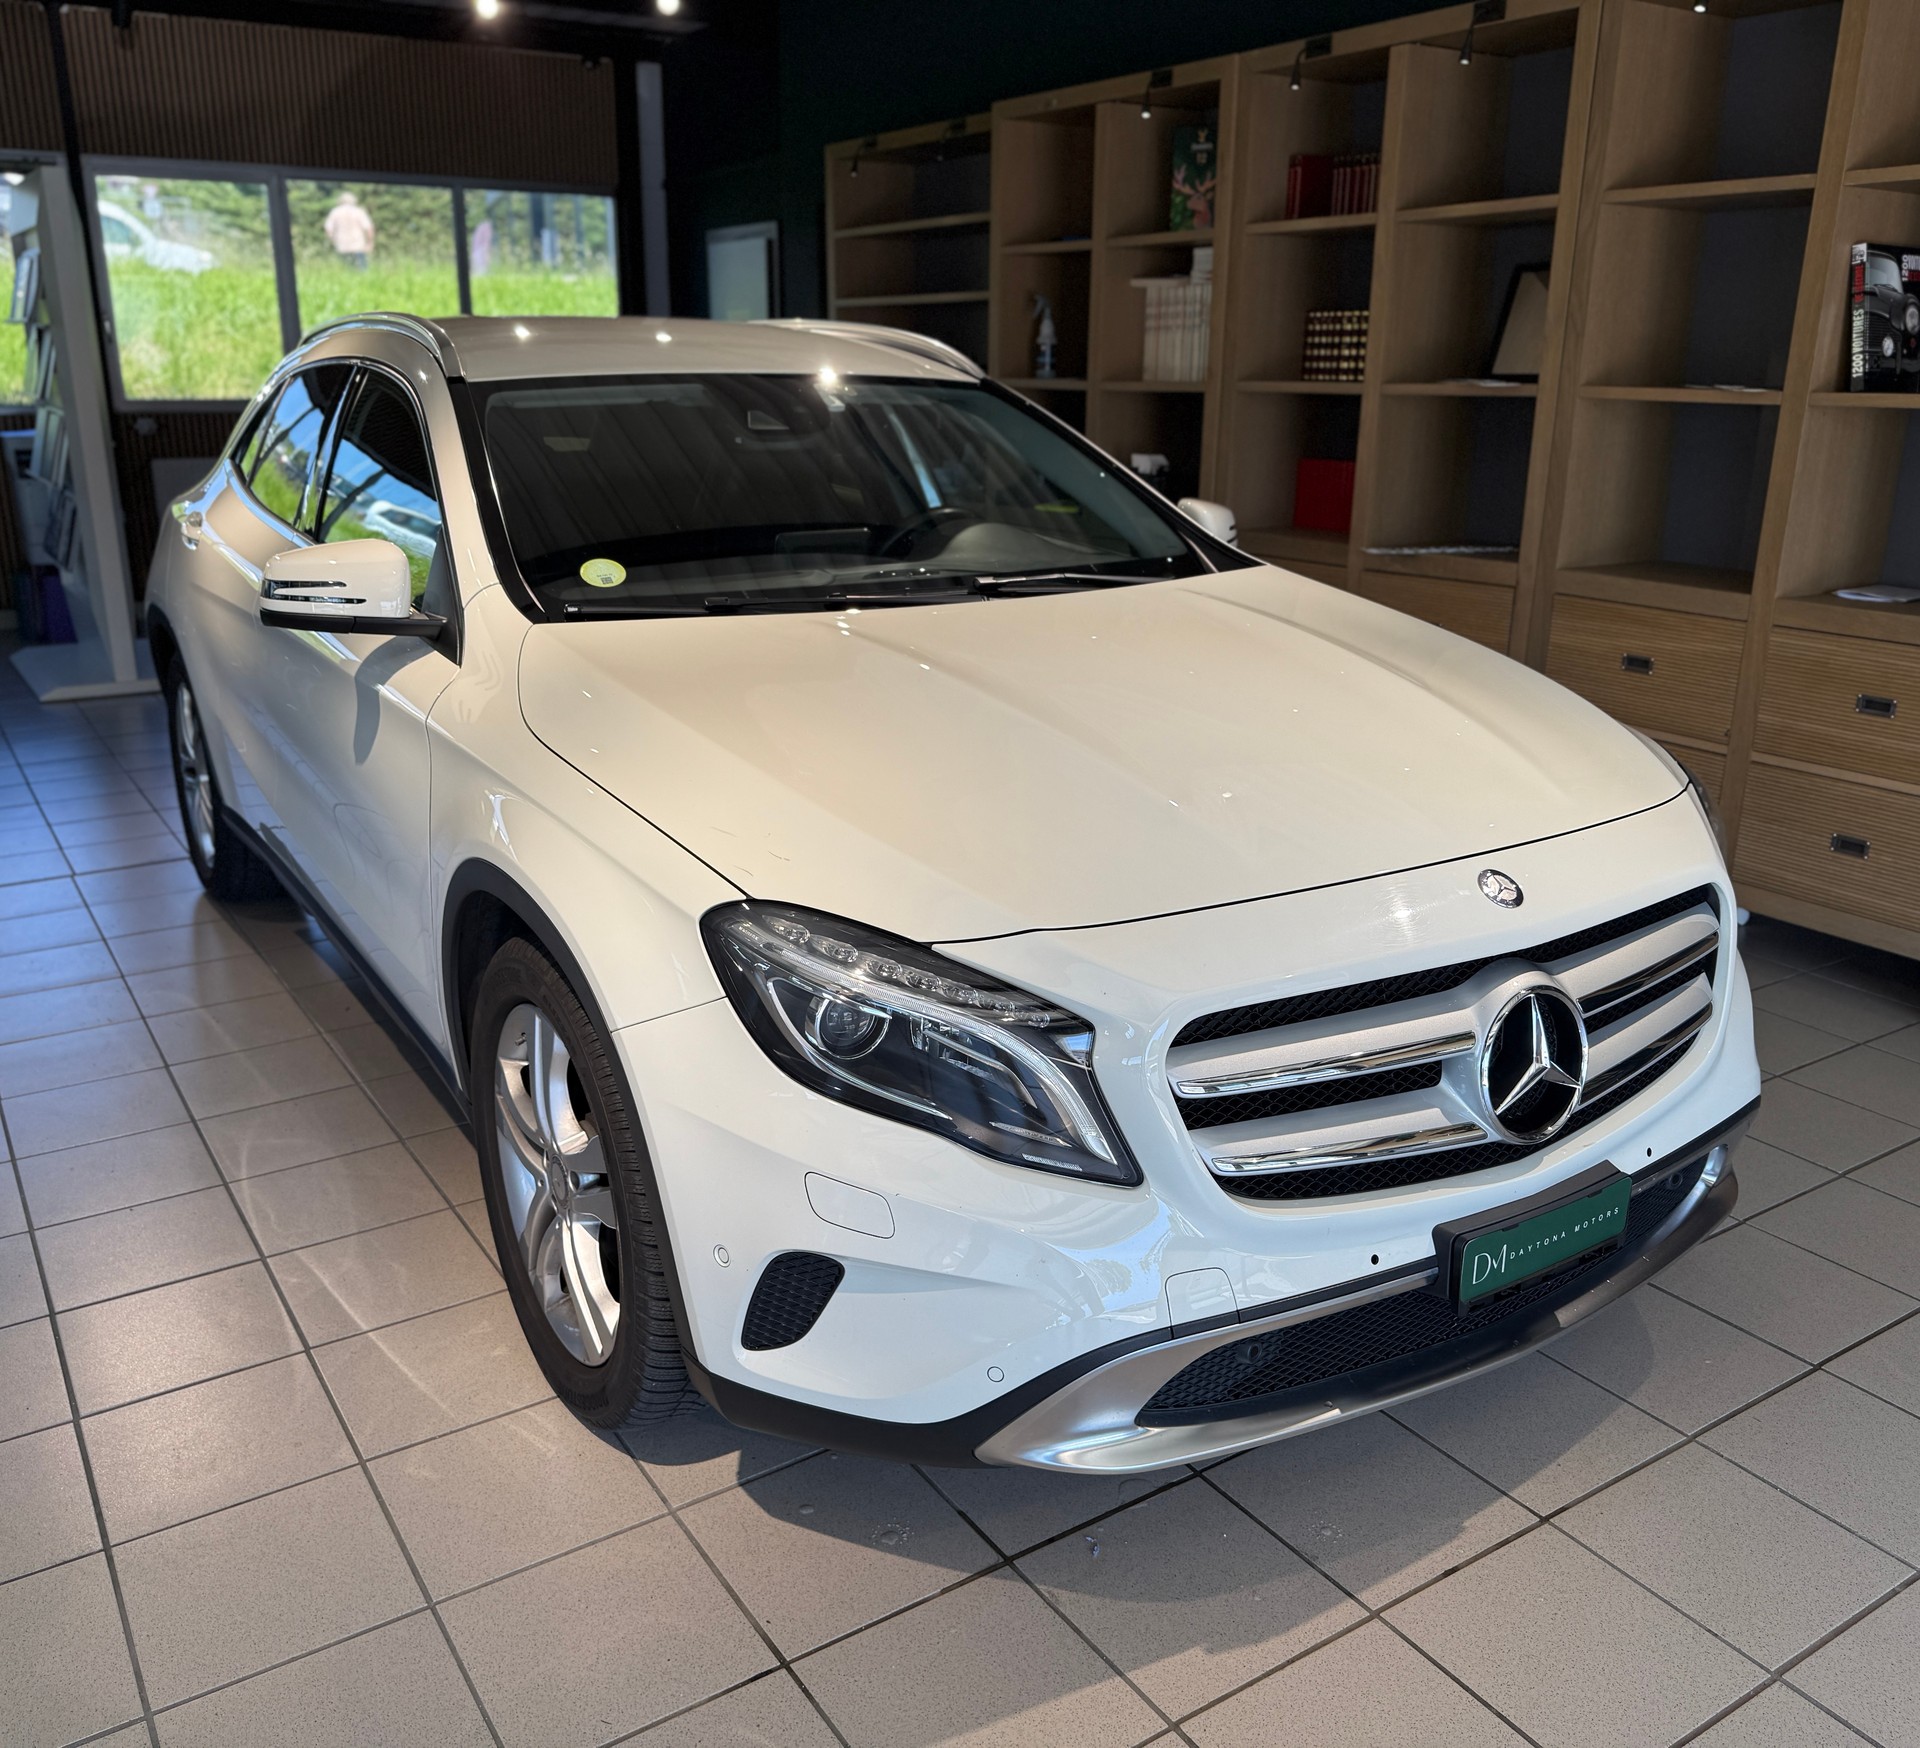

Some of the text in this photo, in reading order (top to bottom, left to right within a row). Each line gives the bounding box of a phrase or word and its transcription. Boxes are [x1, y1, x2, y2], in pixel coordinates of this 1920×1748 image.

[1853, 308, 1864, 354] VOITURES
[1852, 354, 1863, 378] 1200
[1510, 1231, 1566, 1260] DAYTONA
[1574, 1206, 1620, 1233] MOTORS
